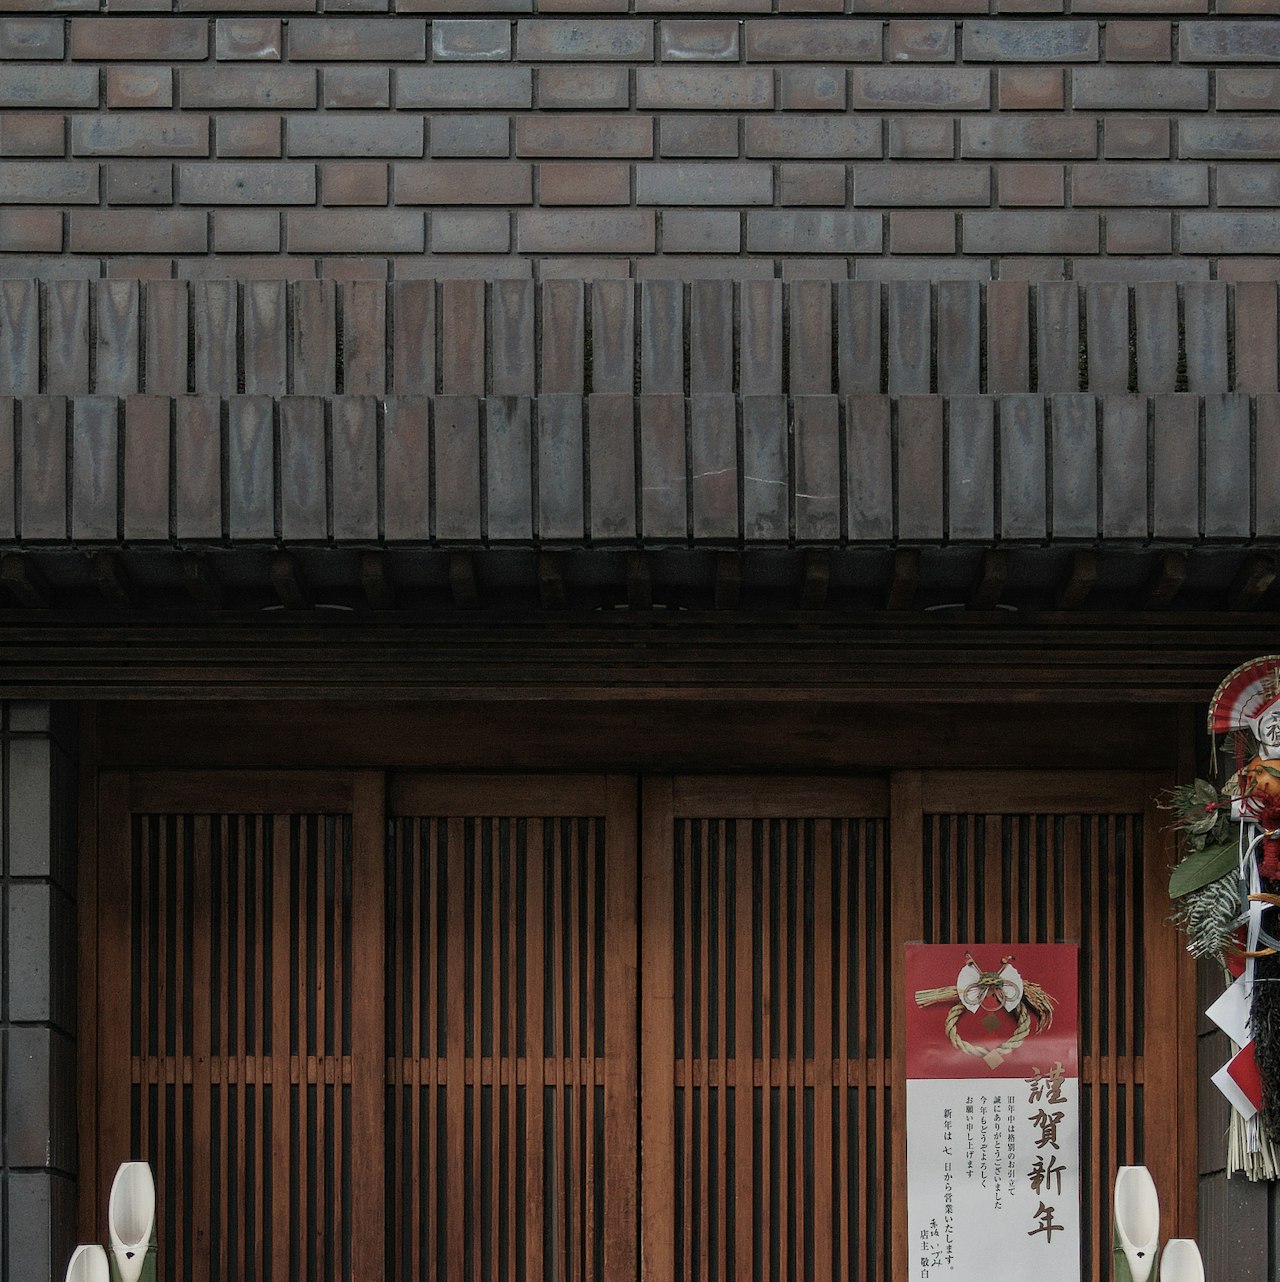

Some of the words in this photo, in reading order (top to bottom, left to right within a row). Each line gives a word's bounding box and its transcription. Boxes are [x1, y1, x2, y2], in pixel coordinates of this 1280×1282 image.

[965, 1095, 975, 1179] お願い申し上げます
[979, 1095, 989, 1189] 今年もどうぞよろしく
[993, 1095, 1003, 1210] 誠にありがとうございました
[1007, 1095, 1016, 1196] 旧年中は格別のお引立て
[1025, 1061, 1068, 1244] 謹賀新年
